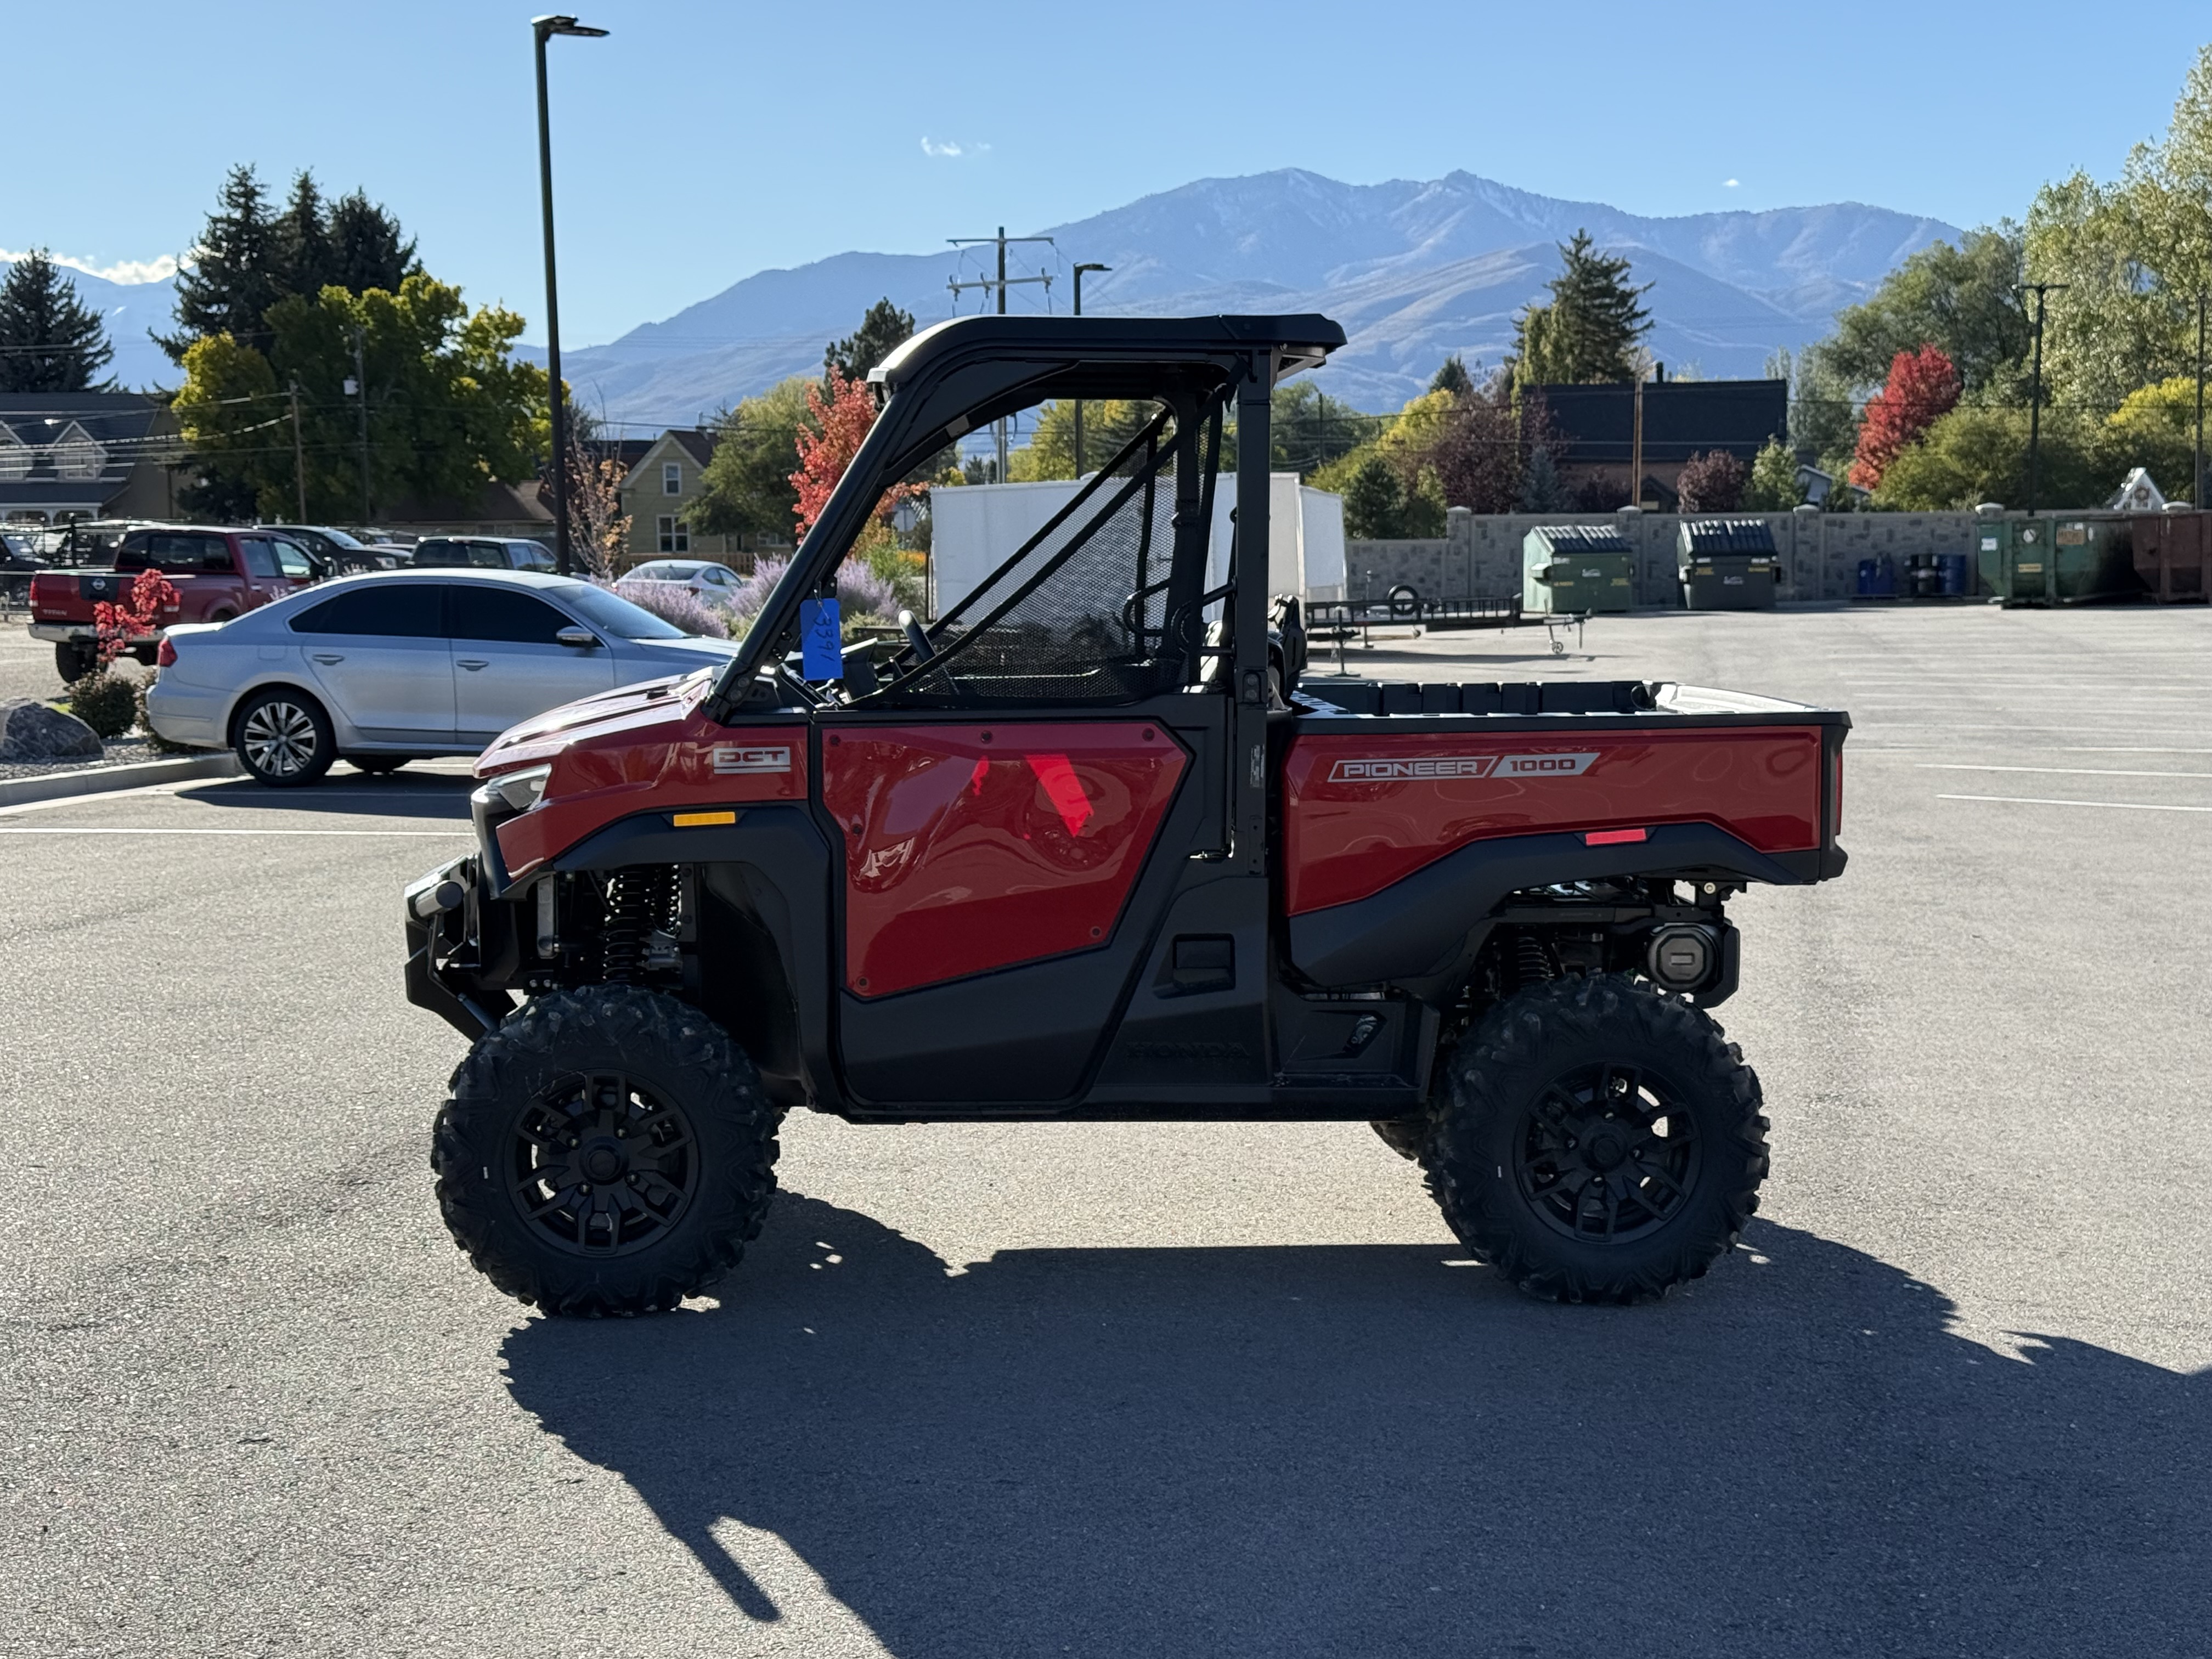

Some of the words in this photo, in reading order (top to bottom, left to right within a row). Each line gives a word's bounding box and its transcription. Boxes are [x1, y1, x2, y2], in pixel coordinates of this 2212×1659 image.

[814, 617, 835, 662] 3391
[719, 750, 786, 763] DCT
[1343, 760, 1478, 778] PIONEER
[1509, 758, 1576, 772] 1000
[1126, 1041, 1250, 1058] HONDA
